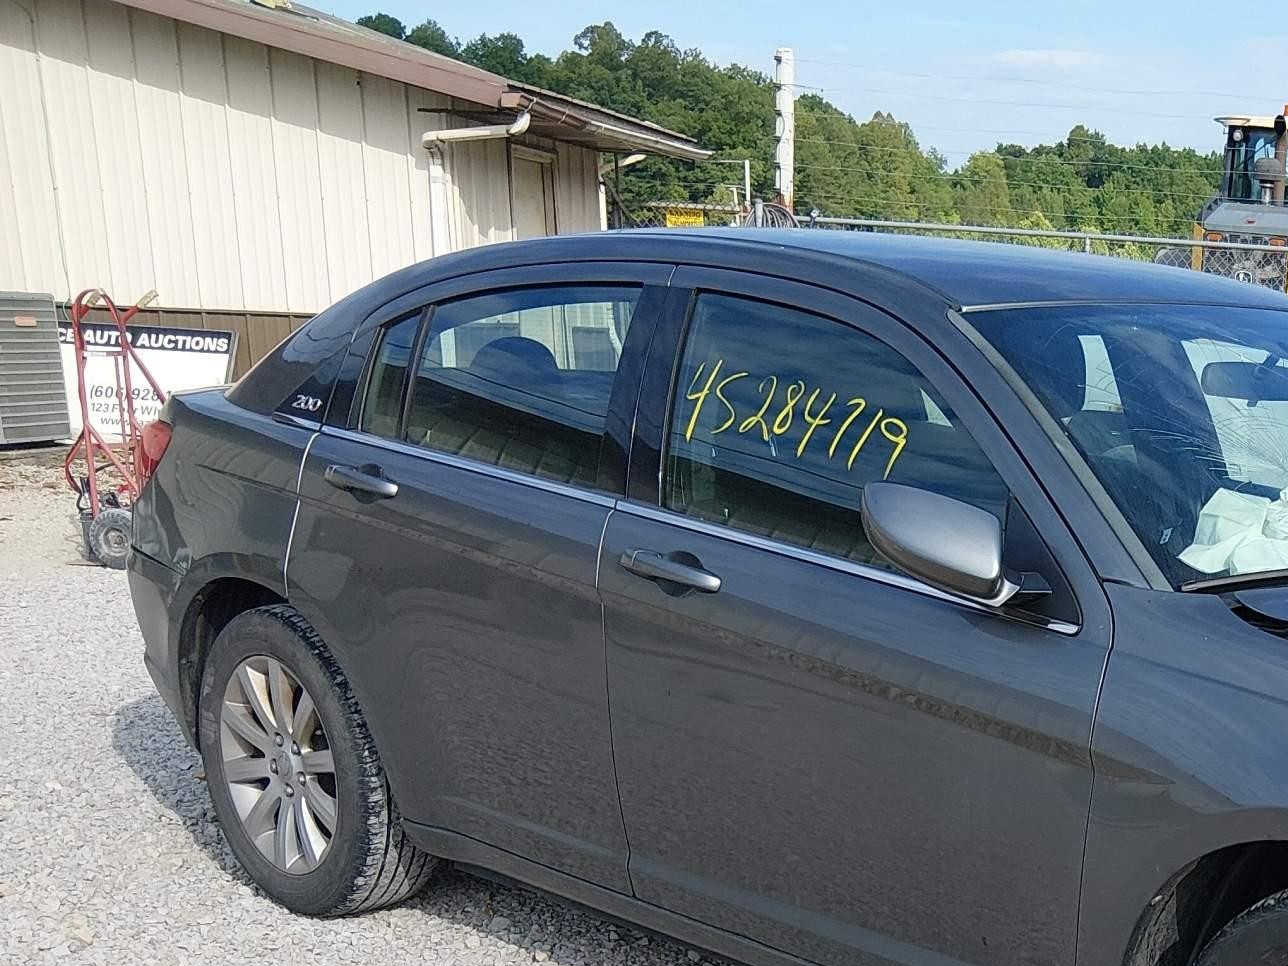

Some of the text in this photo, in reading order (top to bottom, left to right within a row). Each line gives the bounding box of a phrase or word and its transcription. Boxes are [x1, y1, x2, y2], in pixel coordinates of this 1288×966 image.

[84, 329, 132, 346] AUTO
[136, 332, 229, 352] AUCTIONS
[90, 402, 109, 413] 123
[291, 394, 323, 411] 200
[686, 359, 908, 481] 45284719
